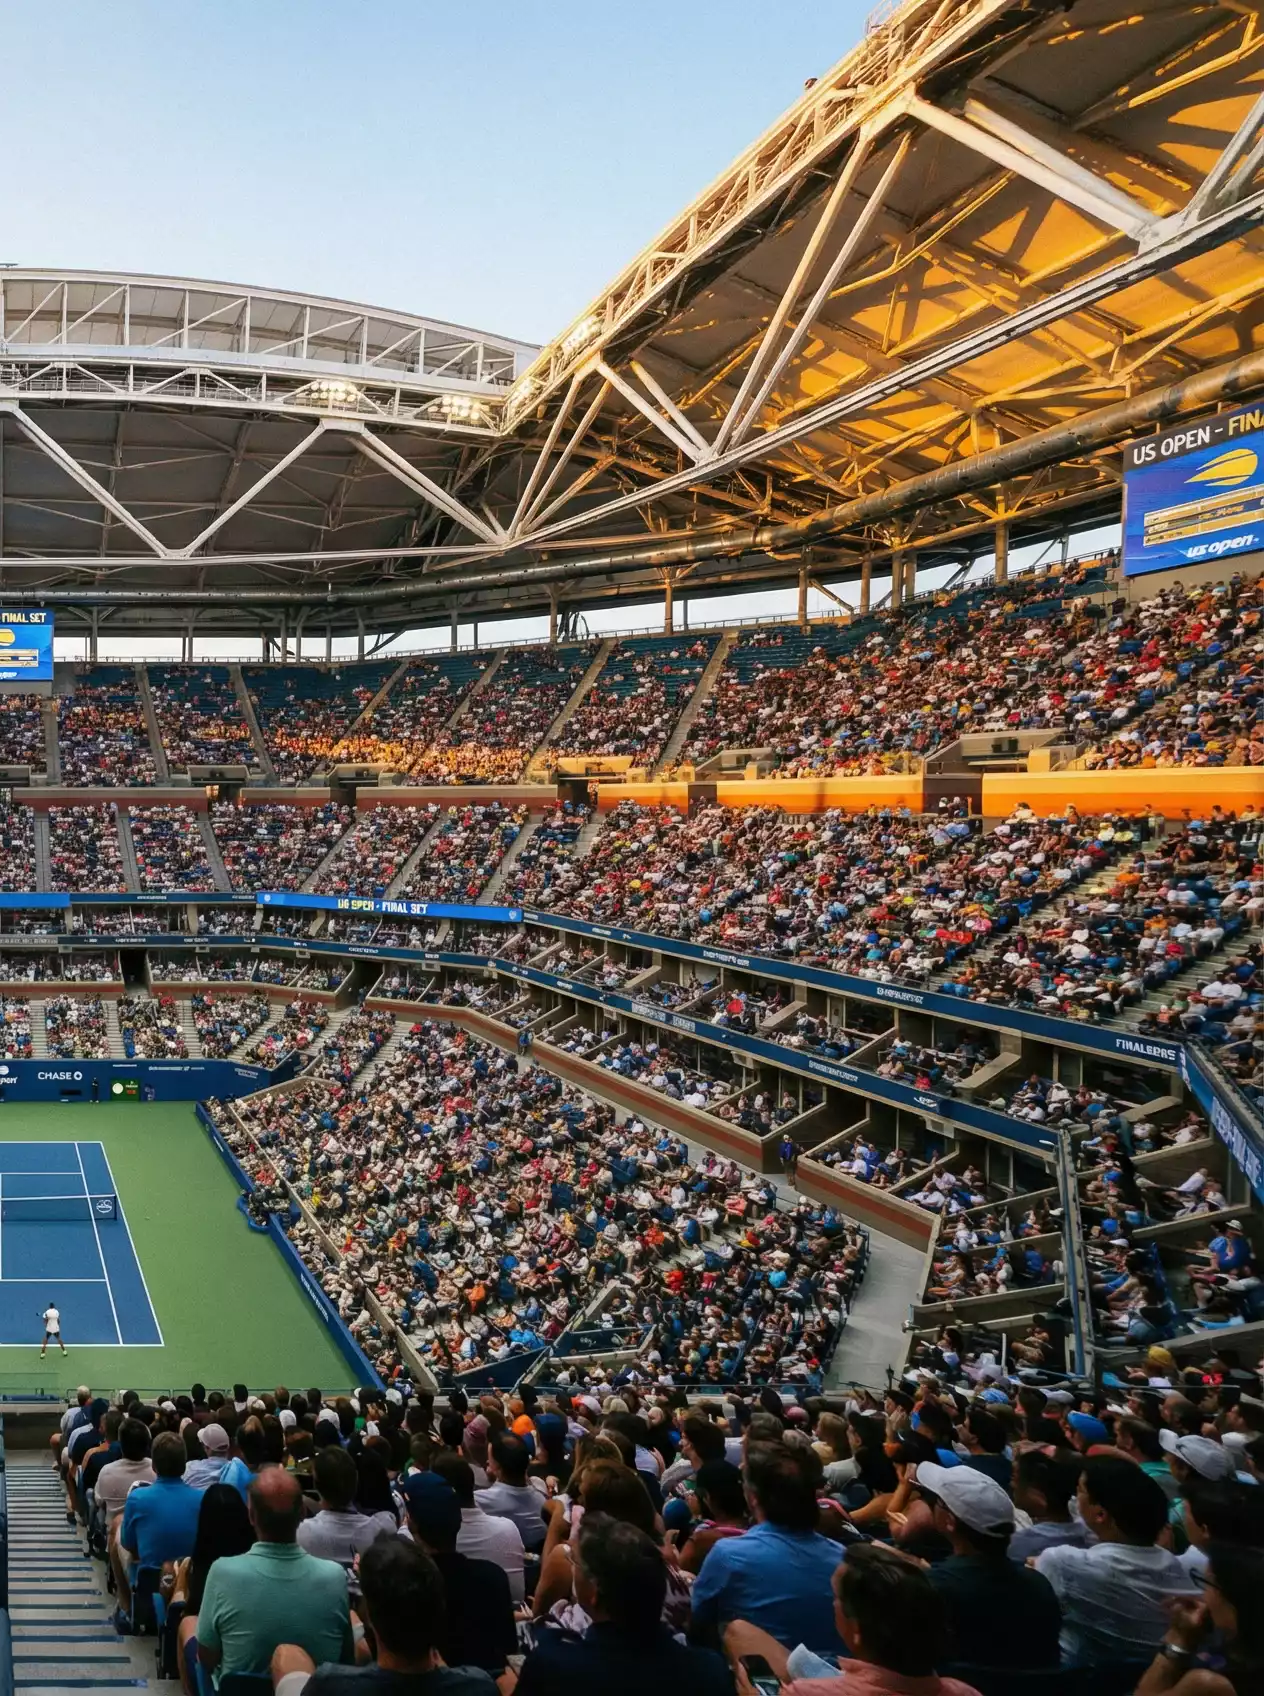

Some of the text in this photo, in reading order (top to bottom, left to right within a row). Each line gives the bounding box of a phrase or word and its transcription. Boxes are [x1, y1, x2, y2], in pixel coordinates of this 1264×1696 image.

[1133, 443, 1157, 465] US
[1161, 426, 1211, 456] OPEN
[29, 612, 47, 623] SET
[37, 1071, 72, 1080] CHASE
